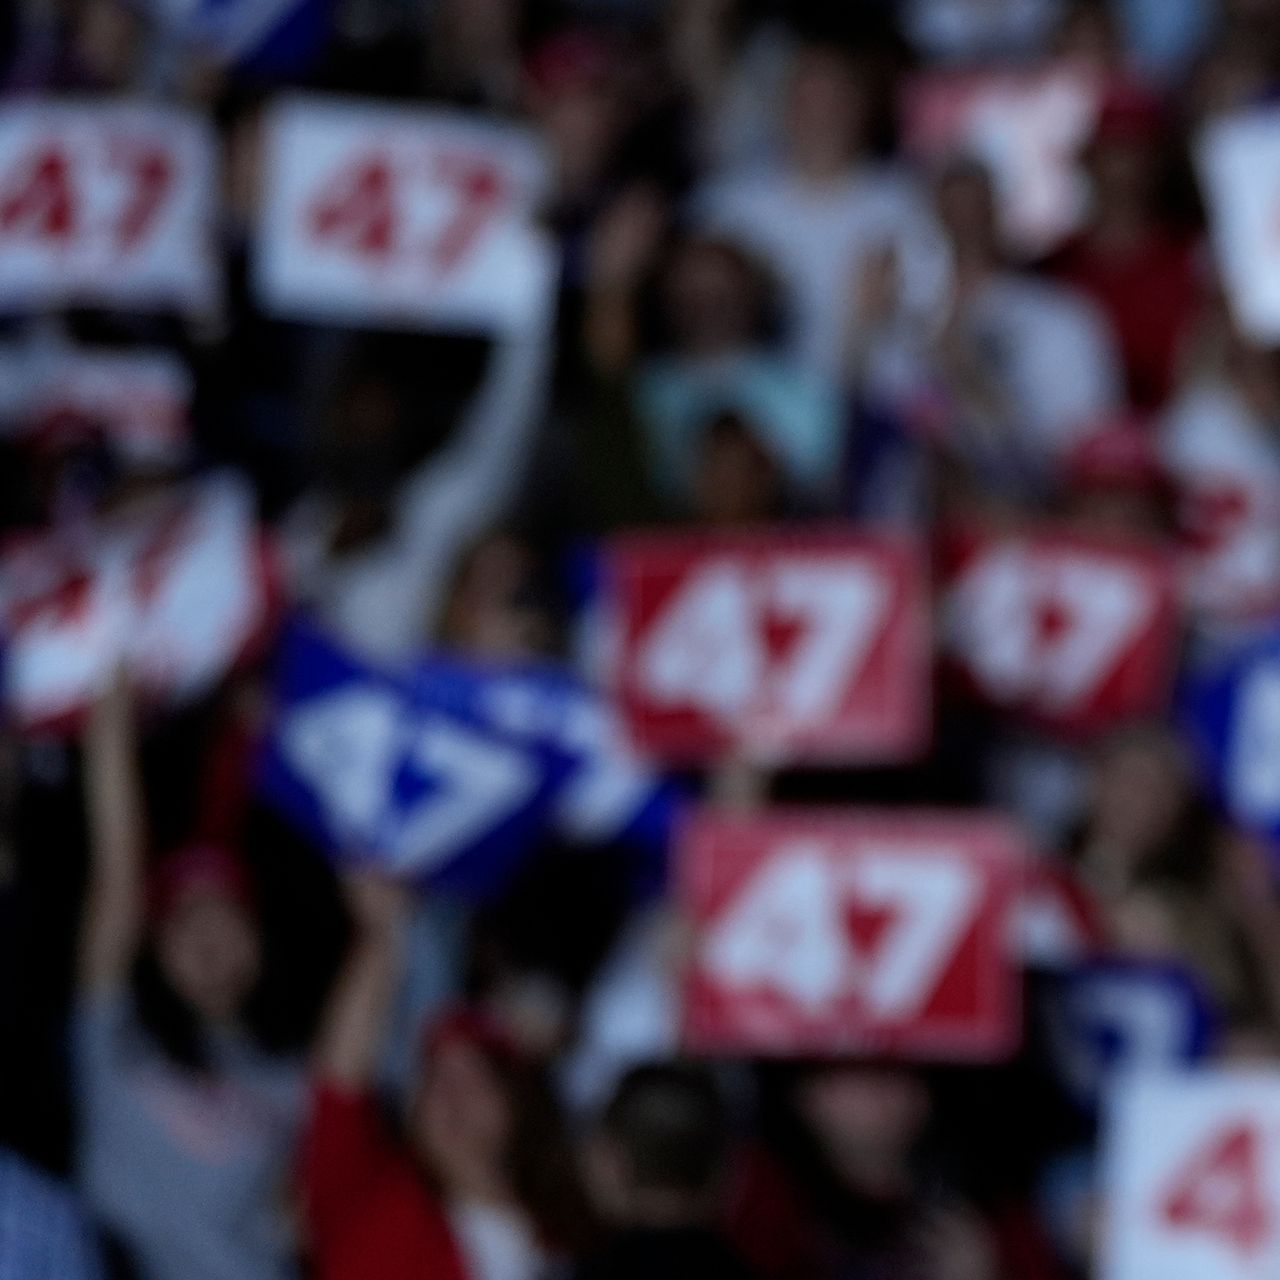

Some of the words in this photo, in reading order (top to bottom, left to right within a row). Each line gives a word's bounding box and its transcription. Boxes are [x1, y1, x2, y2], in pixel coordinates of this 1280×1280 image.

[0, 132, 172, 258] 47
[308, 150, 506, 278] 47
[636, 556, 890, 734] 47
[948, 544, 1160, 716] 47
[278, 682, 548, 884] 47
[698, 834, 980, 1022] 47
